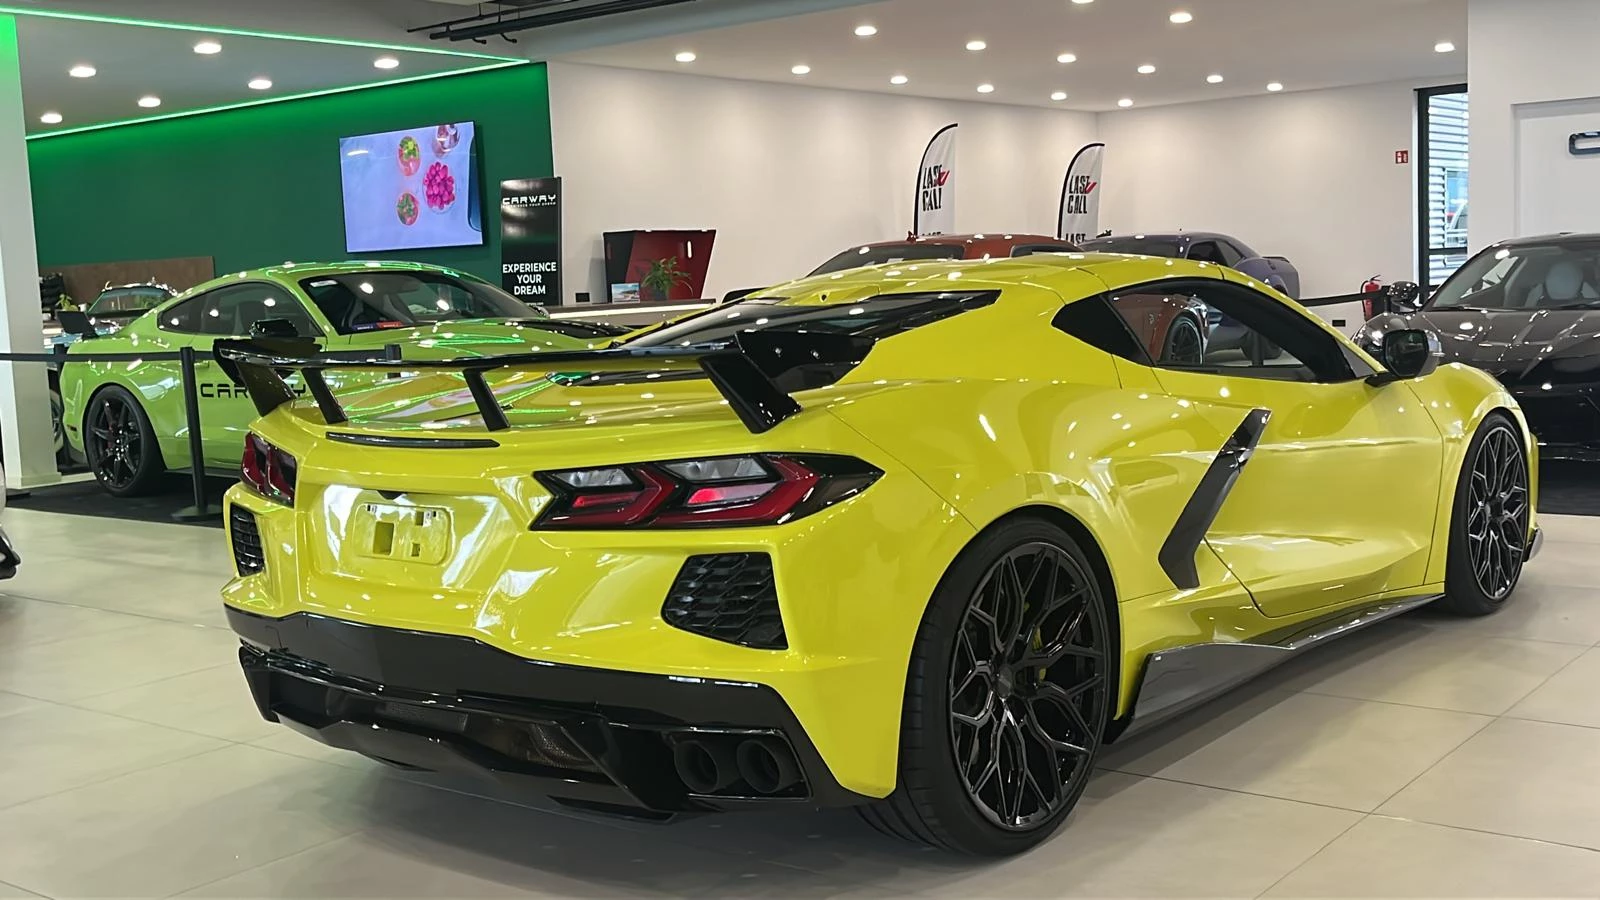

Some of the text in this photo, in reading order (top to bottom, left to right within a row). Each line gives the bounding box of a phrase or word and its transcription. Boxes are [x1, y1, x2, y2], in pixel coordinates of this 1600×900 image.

[1069, 175, 1090, 194] LAST
[502, 194, 556, 205] CARWAY
[1067, 195, 1087, 214] CALL
[502, 262, 557, 273] EXPERIENCE
[516, 274, 542, 284] YOUR
[513, 285, 546, 295] DREAM
[200, 383, 306, 398] CARY
